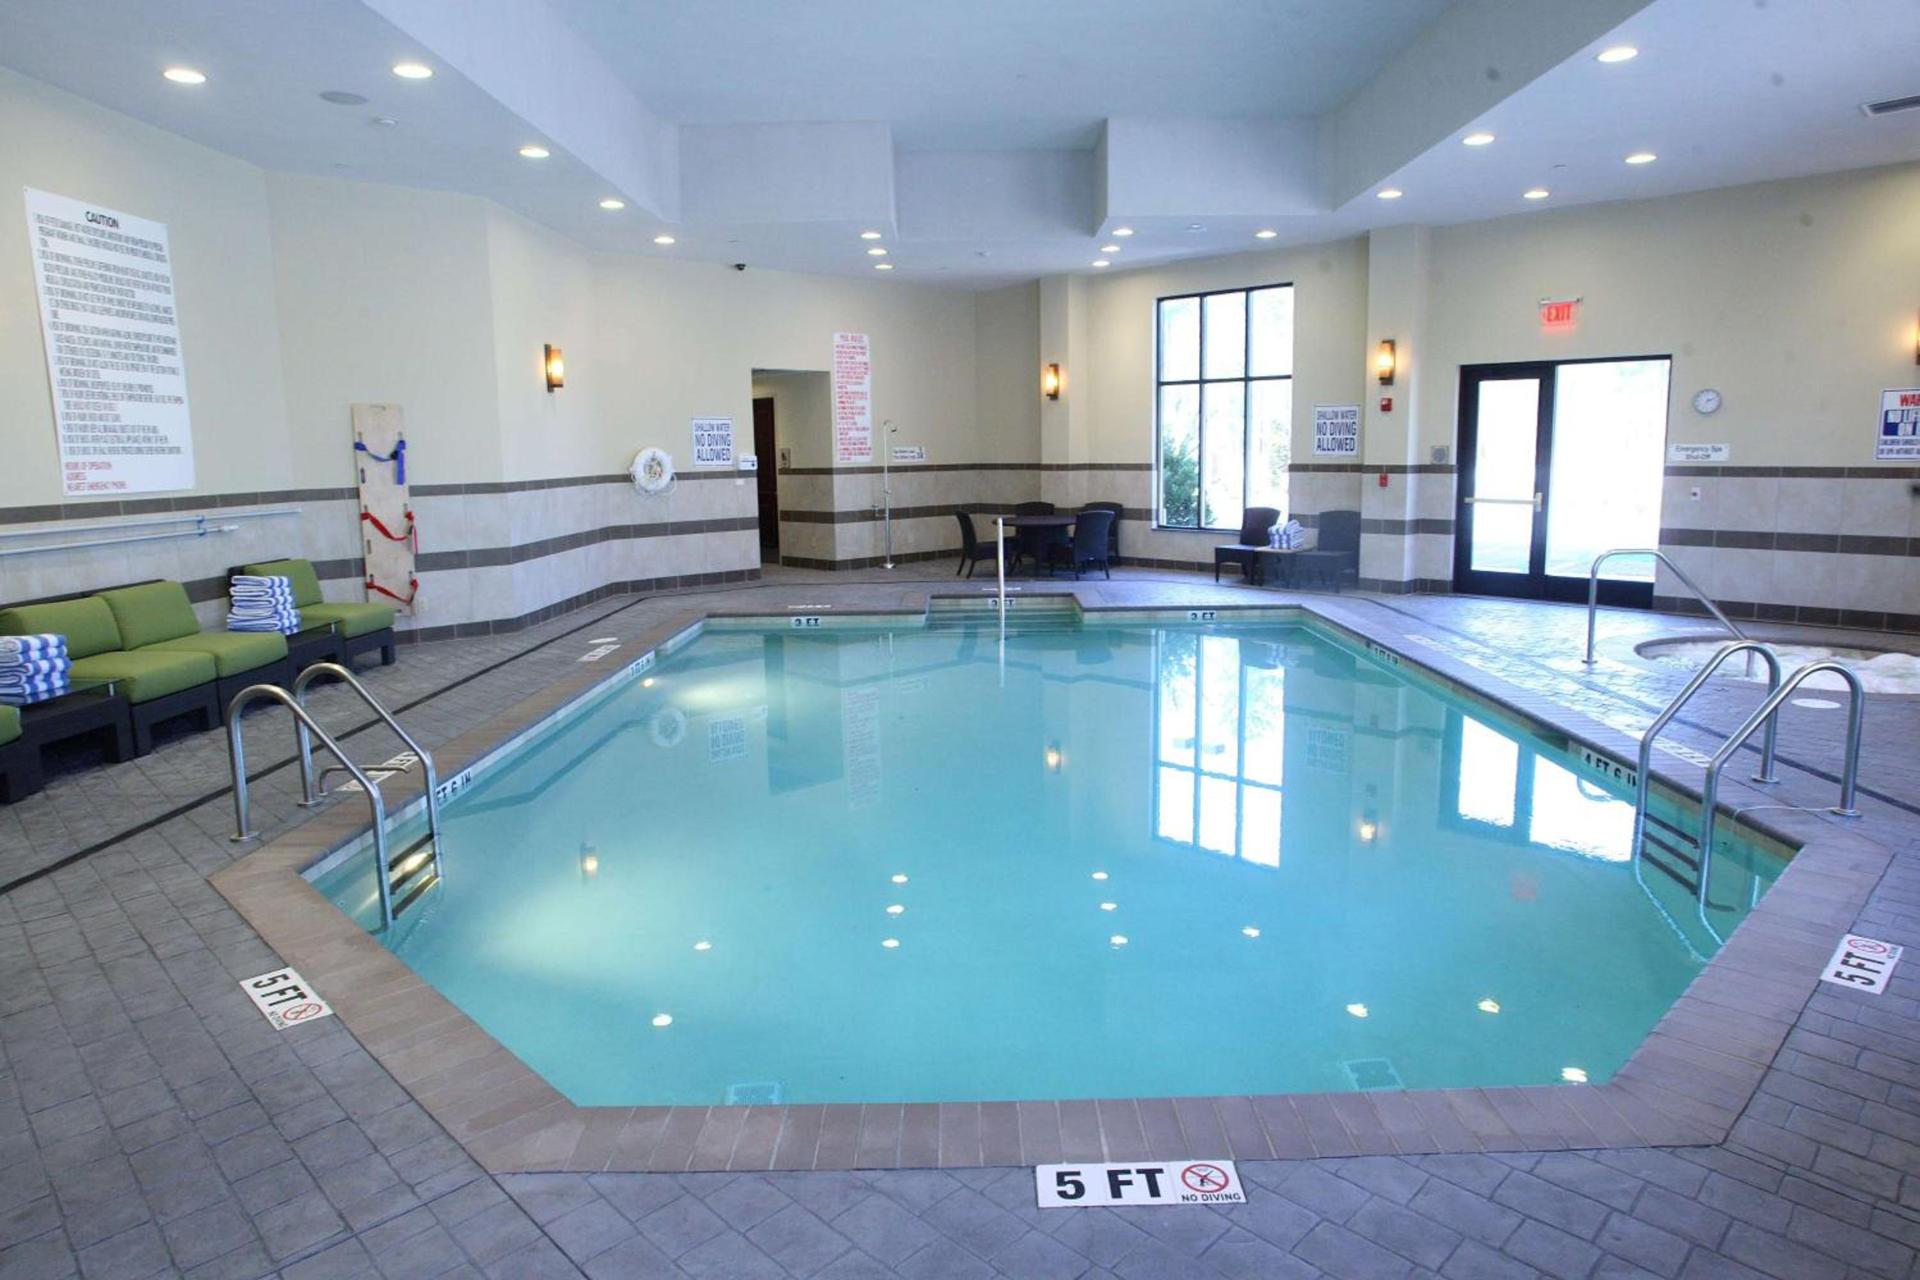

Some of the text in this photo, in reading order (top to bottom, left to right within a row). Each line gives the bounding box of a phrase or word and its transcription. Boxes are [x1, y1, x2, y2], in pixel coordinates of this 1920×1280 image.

[85, 210, 119, 229] CAUTION
[1546, 303, 1571, 321] EXIT
[1317, 410, 1356, 420] SHALLOW WATER
[695, 423, 730, 432] SHALLOW WATER
[1316, 421, 1356, 436] NO DIVING
[695, 433, 731, 446] NO DIVING
[1316, 437, 1355, 451] ALLOWED
[696, 448, 731, 461] ALLOWED
[1833, 951, 1886, 987] 5 FT
[252, 973, 290, 989] 5
[261, 985, 307, 1007] FT
[1056, 1168, 1164, 1200] 5 FT
[1181, 1192, 1242, 1202] NO DIVING
